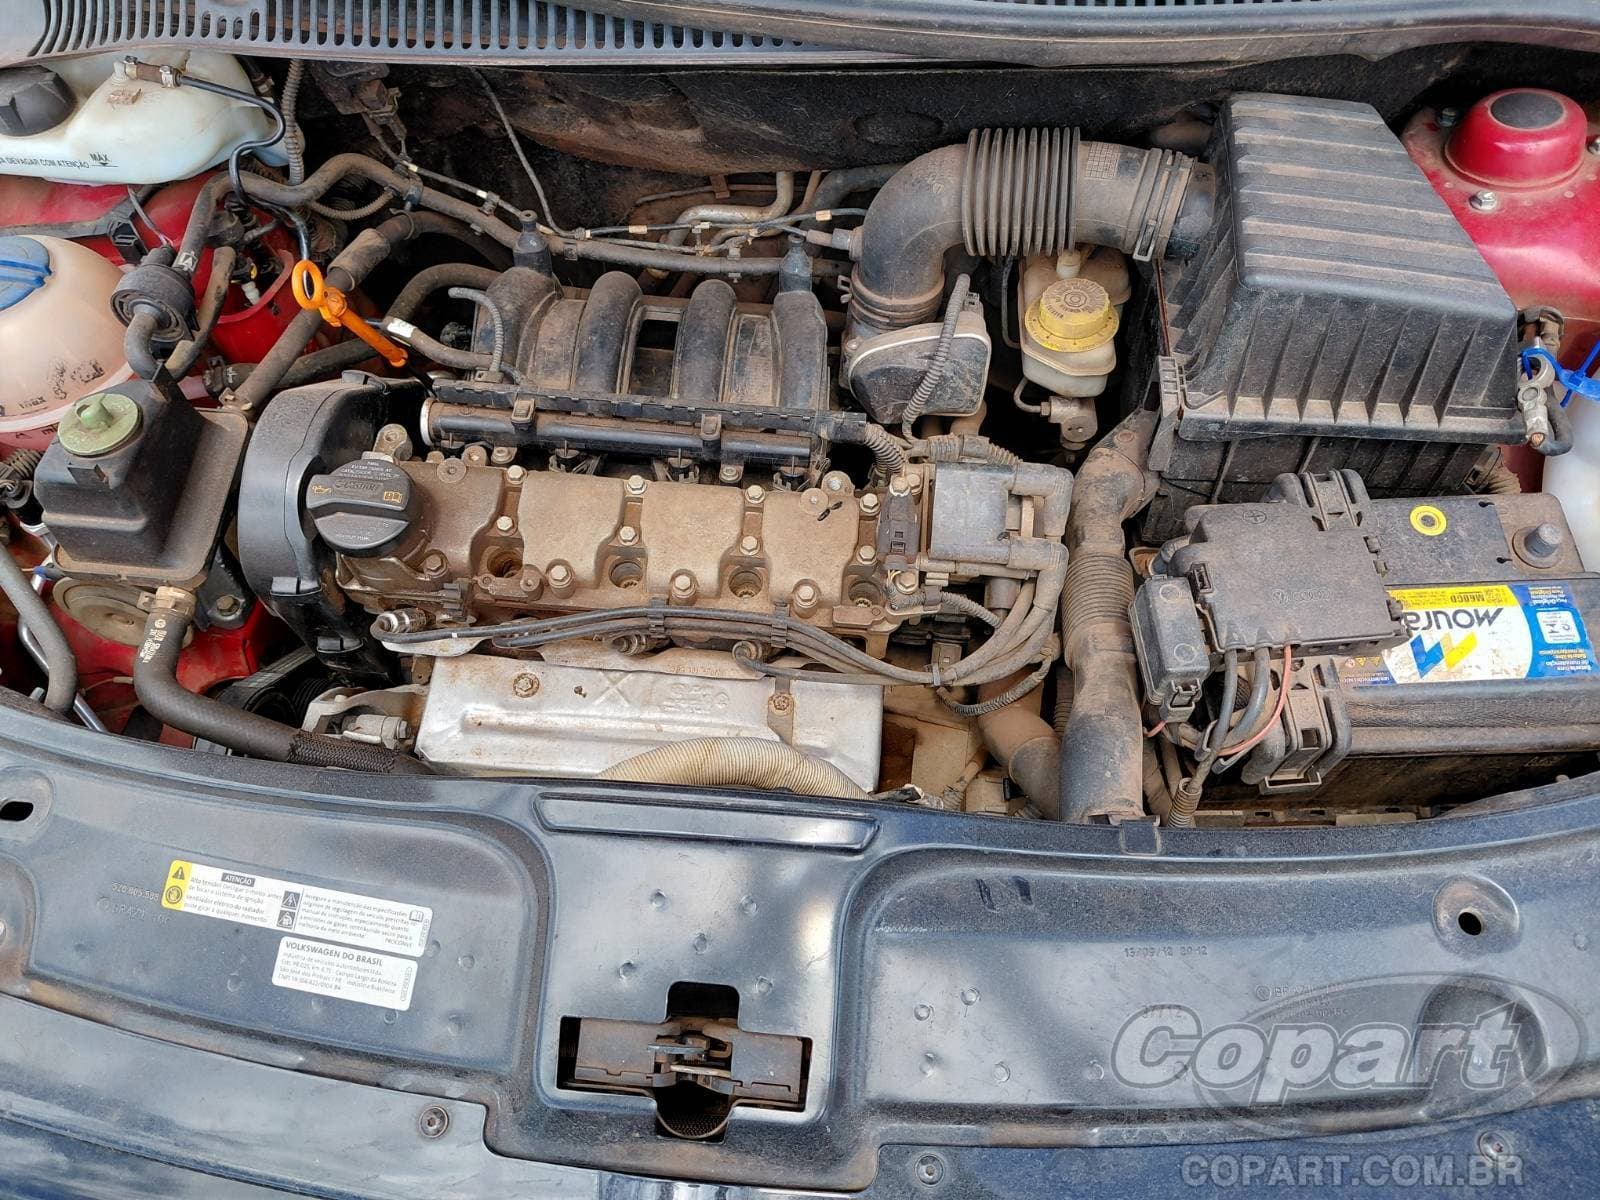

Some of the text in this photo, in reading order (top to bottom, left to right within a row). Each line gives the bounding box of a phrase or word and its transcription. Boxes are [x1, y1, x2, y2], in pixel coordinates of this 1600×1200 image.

[6, 157, 39, 166] DEVAGAR
[57, 160, 90, 169] ATENÇÃO
[225, 874, 252, 885] ATENÇÃO
[285, 941, 383, 967] VOLKSWAGEN DO BRASIL
